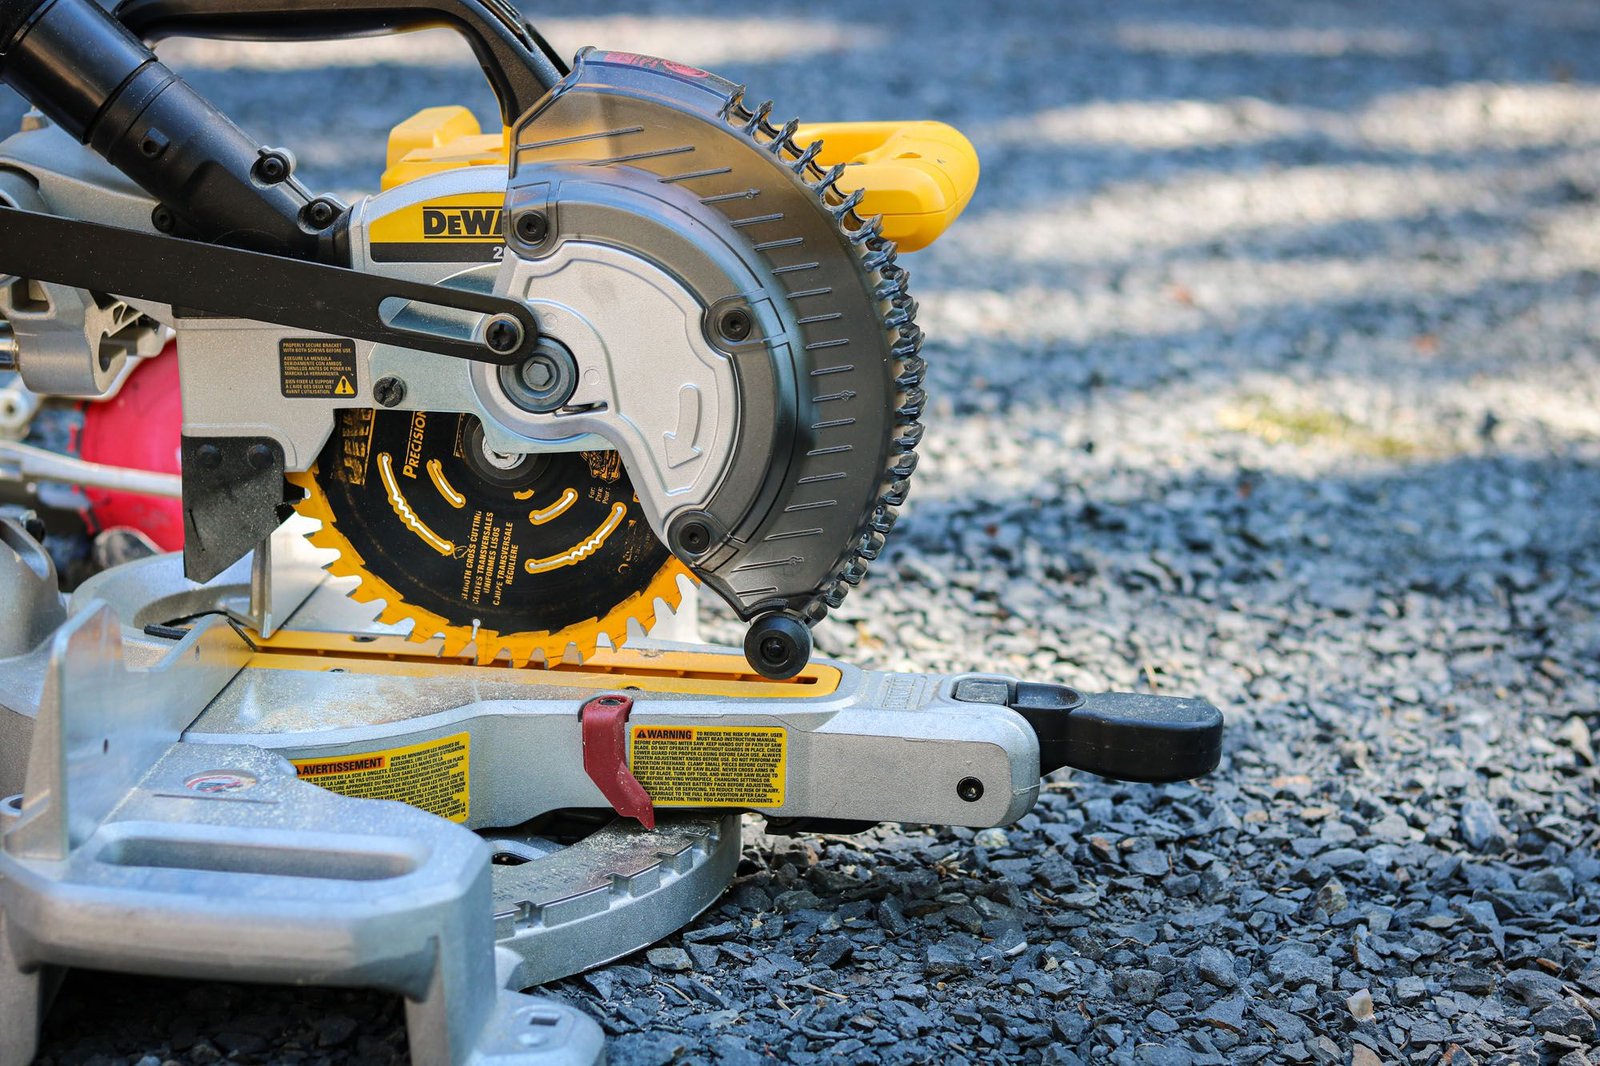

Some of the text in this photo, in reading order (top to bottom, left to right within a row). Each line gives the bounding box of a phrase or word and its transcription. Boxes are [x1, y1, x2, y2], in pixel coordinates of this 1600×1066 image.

[491, 527, 500, 549] LISOS
[466, 543, 476, 569] CROSS
[648, 730, 691, 739] WARNING
[303, 758, 383, 774] AVERTISSEMENT
